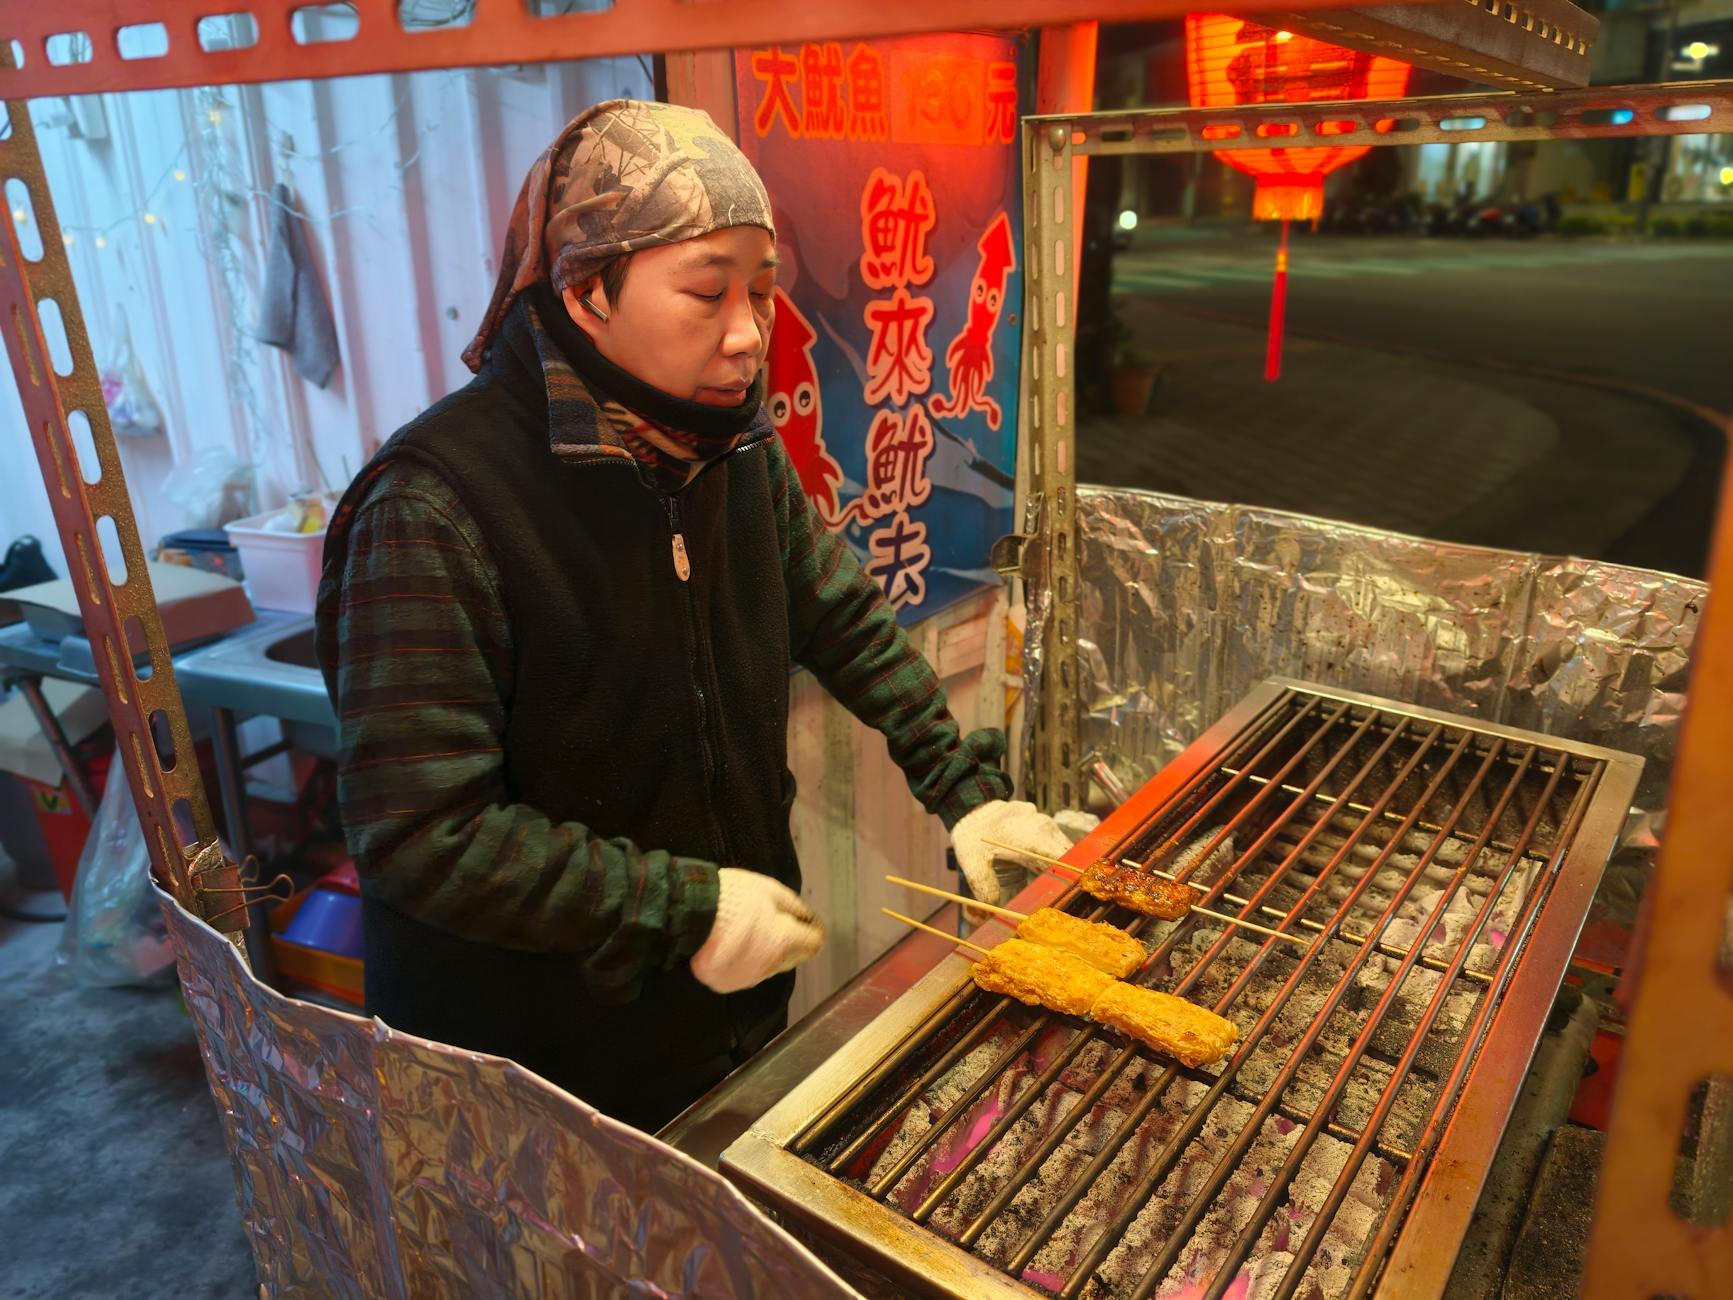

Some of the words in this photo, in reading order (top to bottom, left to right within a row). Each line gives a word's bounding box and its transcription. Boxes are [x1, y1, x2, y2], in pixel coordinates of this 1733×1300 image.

[753, 42, 887, 141] 大魷魚
[861, 168, 935, 609] 魷來魷去
